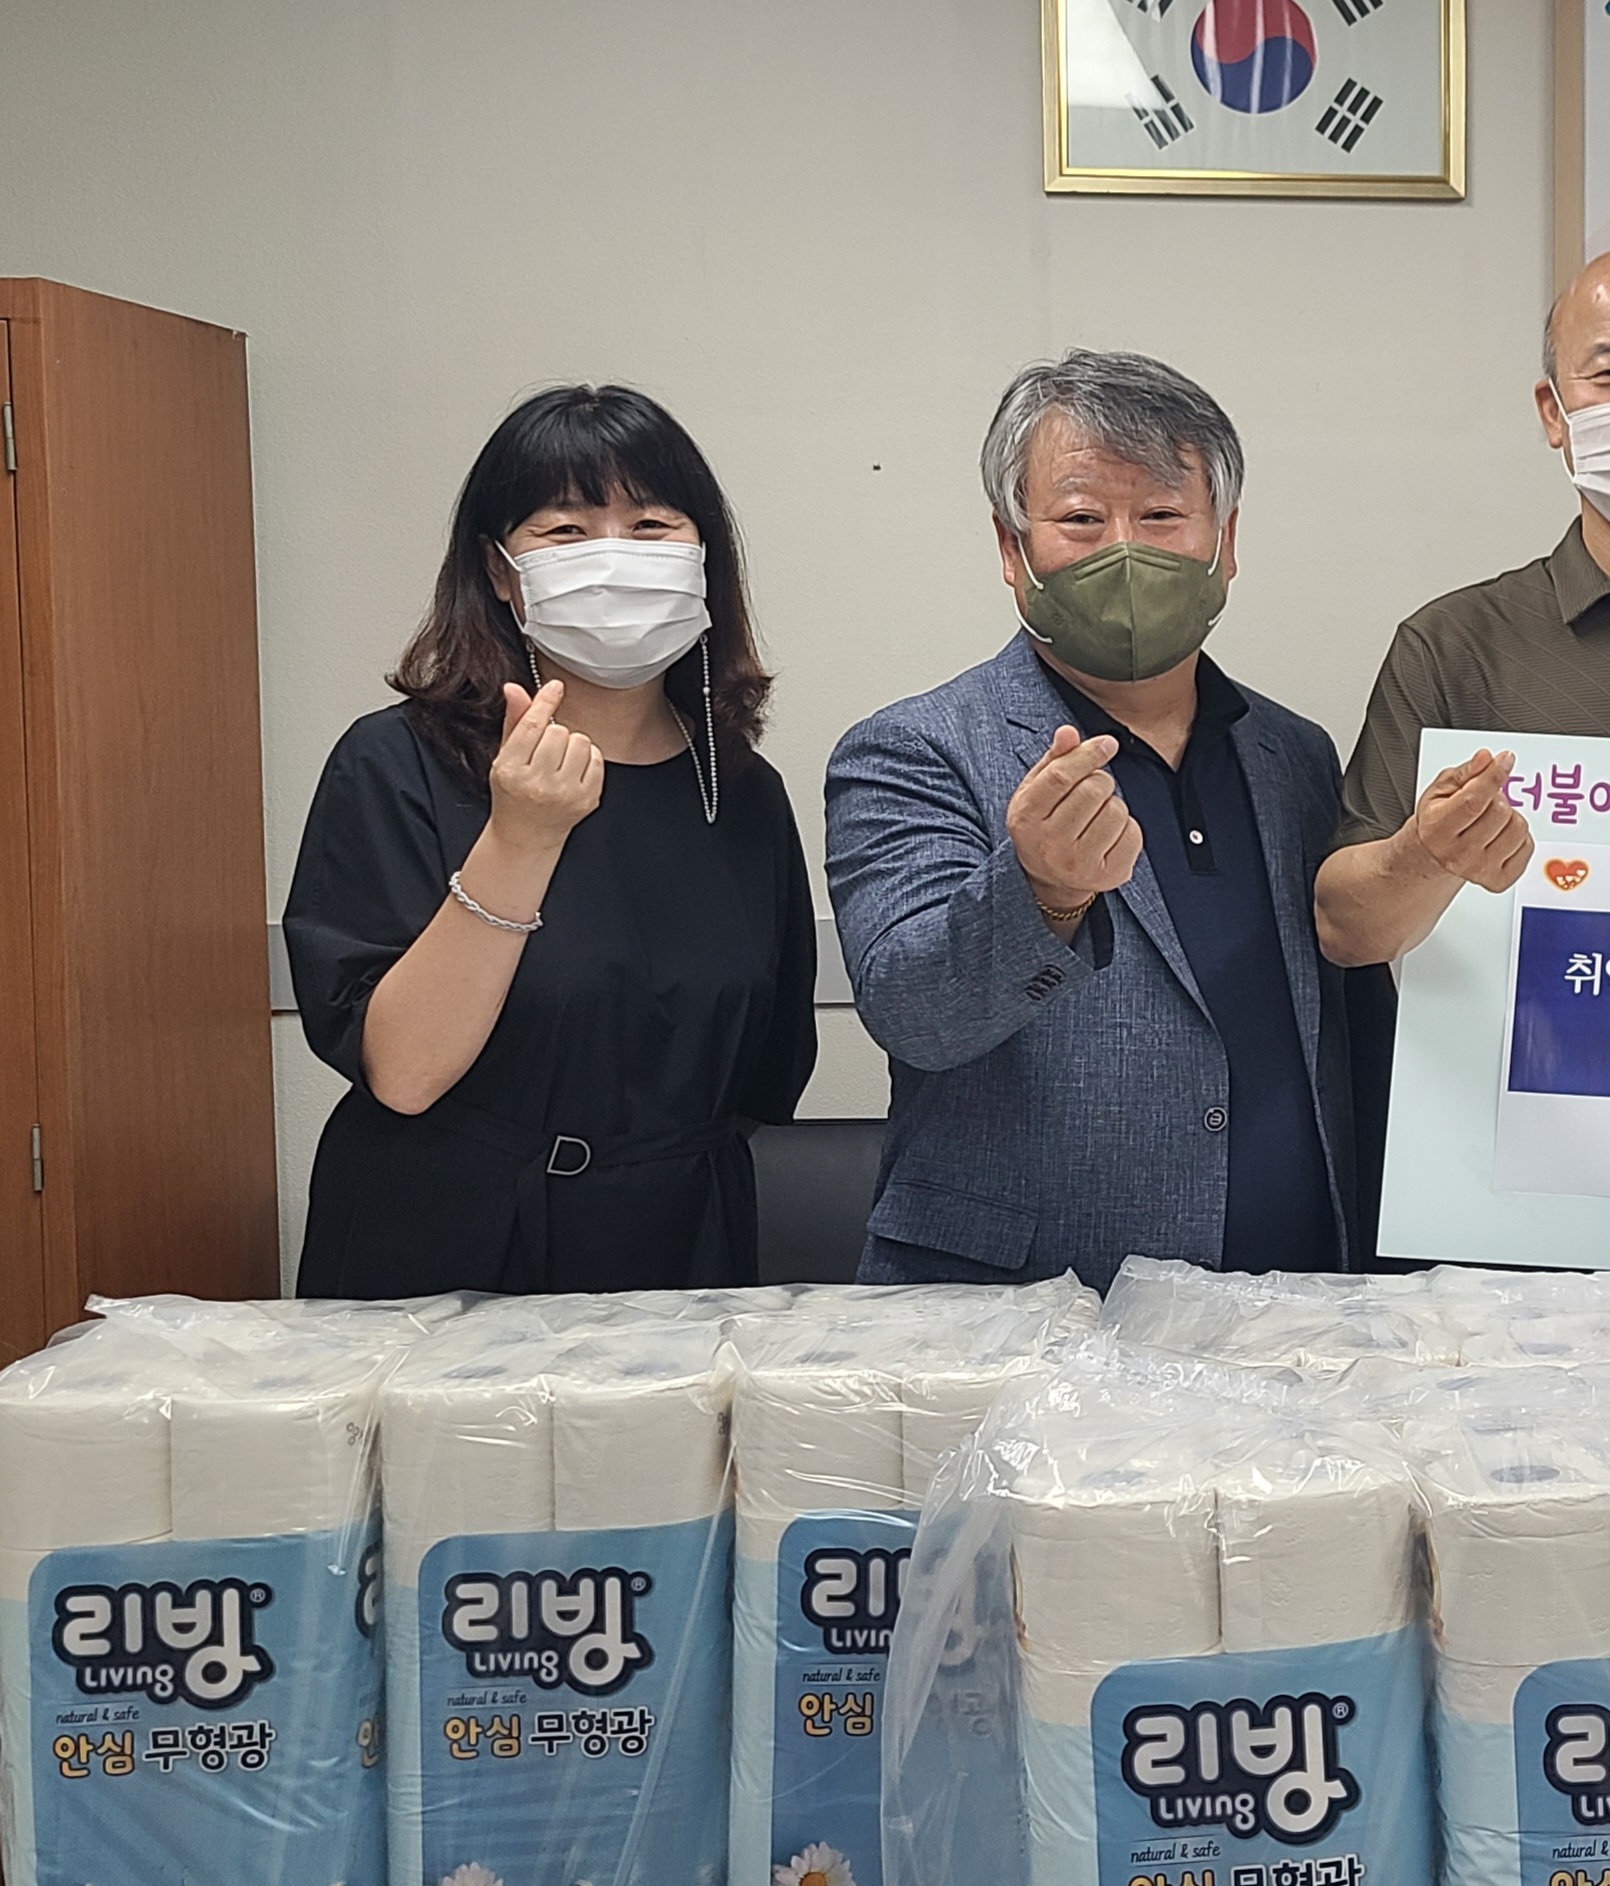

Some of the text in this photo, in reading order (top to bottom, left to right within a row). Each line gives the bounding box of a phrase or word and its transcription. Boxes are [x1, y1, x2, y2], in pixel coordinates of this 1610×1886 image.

[62, 1587, 262, 1700] 리빙
[451, 1576, 641, 1686] 리빙
[803, 1667, 881, 1683] natural & safe
[56, 1705, 141, 1724] natural & safe
[447, 1690, 527, 1707] natural & safe
[799, 1691, 875, 1737] 안심
[53, 1720, 276, 1779] 안심 무형광
[444, 1706, 656, 1760] 안심 무형광
[1133, 1704, 1348, 1833] 리빙
[1130, 1840, 1222, 1864] natural & safe
[1552, 1841, 1597, 1859] natural
[1600, 1840, 1609, 1856] &
